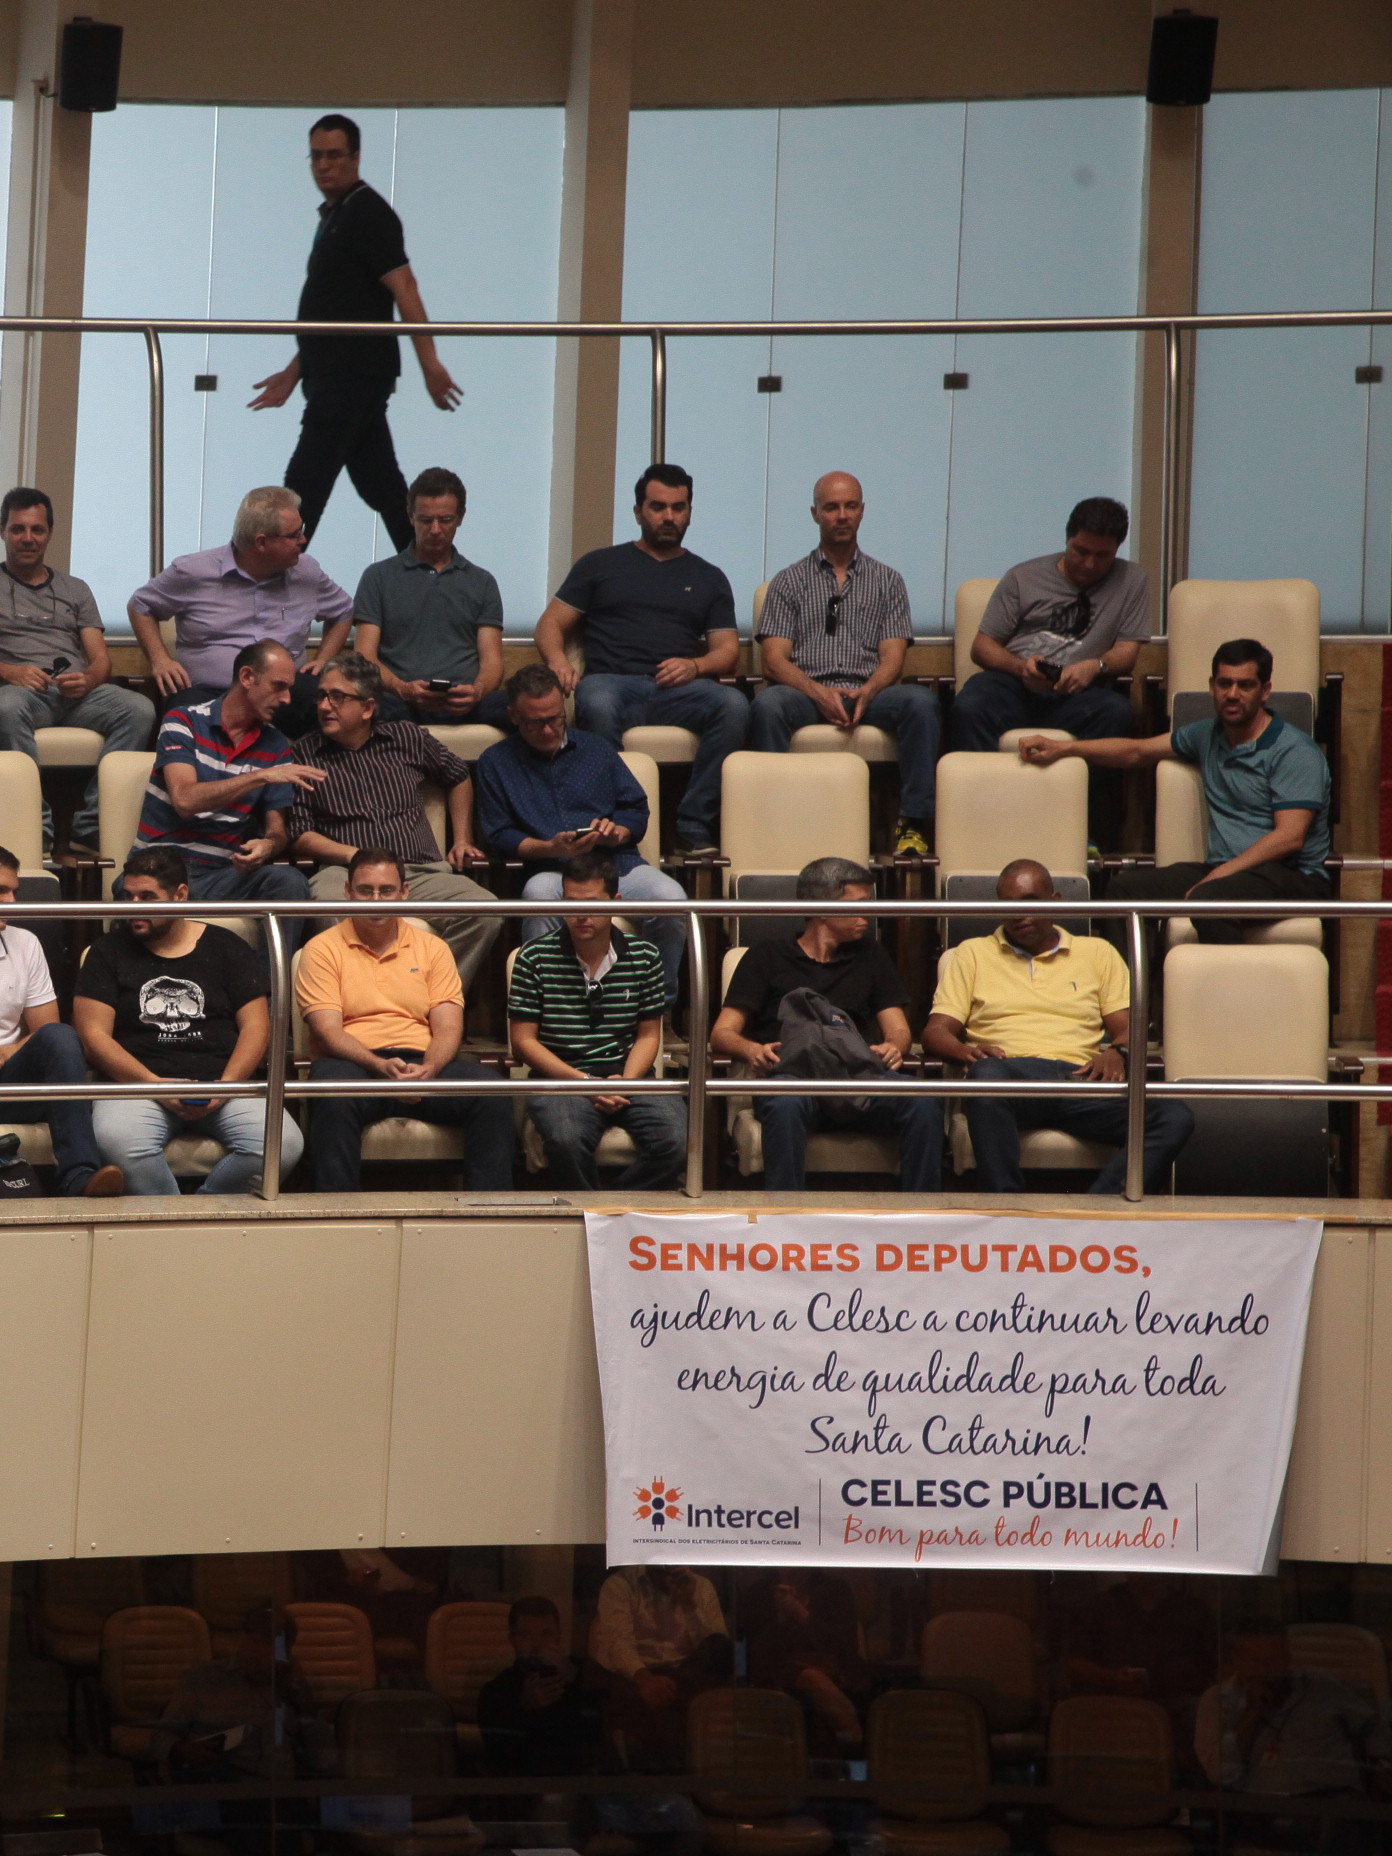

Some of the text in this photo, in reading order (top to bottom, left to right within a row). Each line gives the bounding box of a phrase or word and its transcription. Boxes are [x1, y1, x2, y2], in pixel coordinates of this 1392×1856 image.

[628, 1235, 1153, 1279] SENHORES DEPUTADOS,
[629, 1287, 1270, 1348] ajudem a Celesc a continuar levando
[676, 1348, 1227, 1419] energia de qualidade para toda
[804, 1412, 1092, 1457] Santa Catarina!
[840, 1471, 1169, 1511] CELESC PÚBLICA
[687, 1503, 800, 1530] Intercel
[842, 1513, 1180, 1563] Bom para todo mundo!
